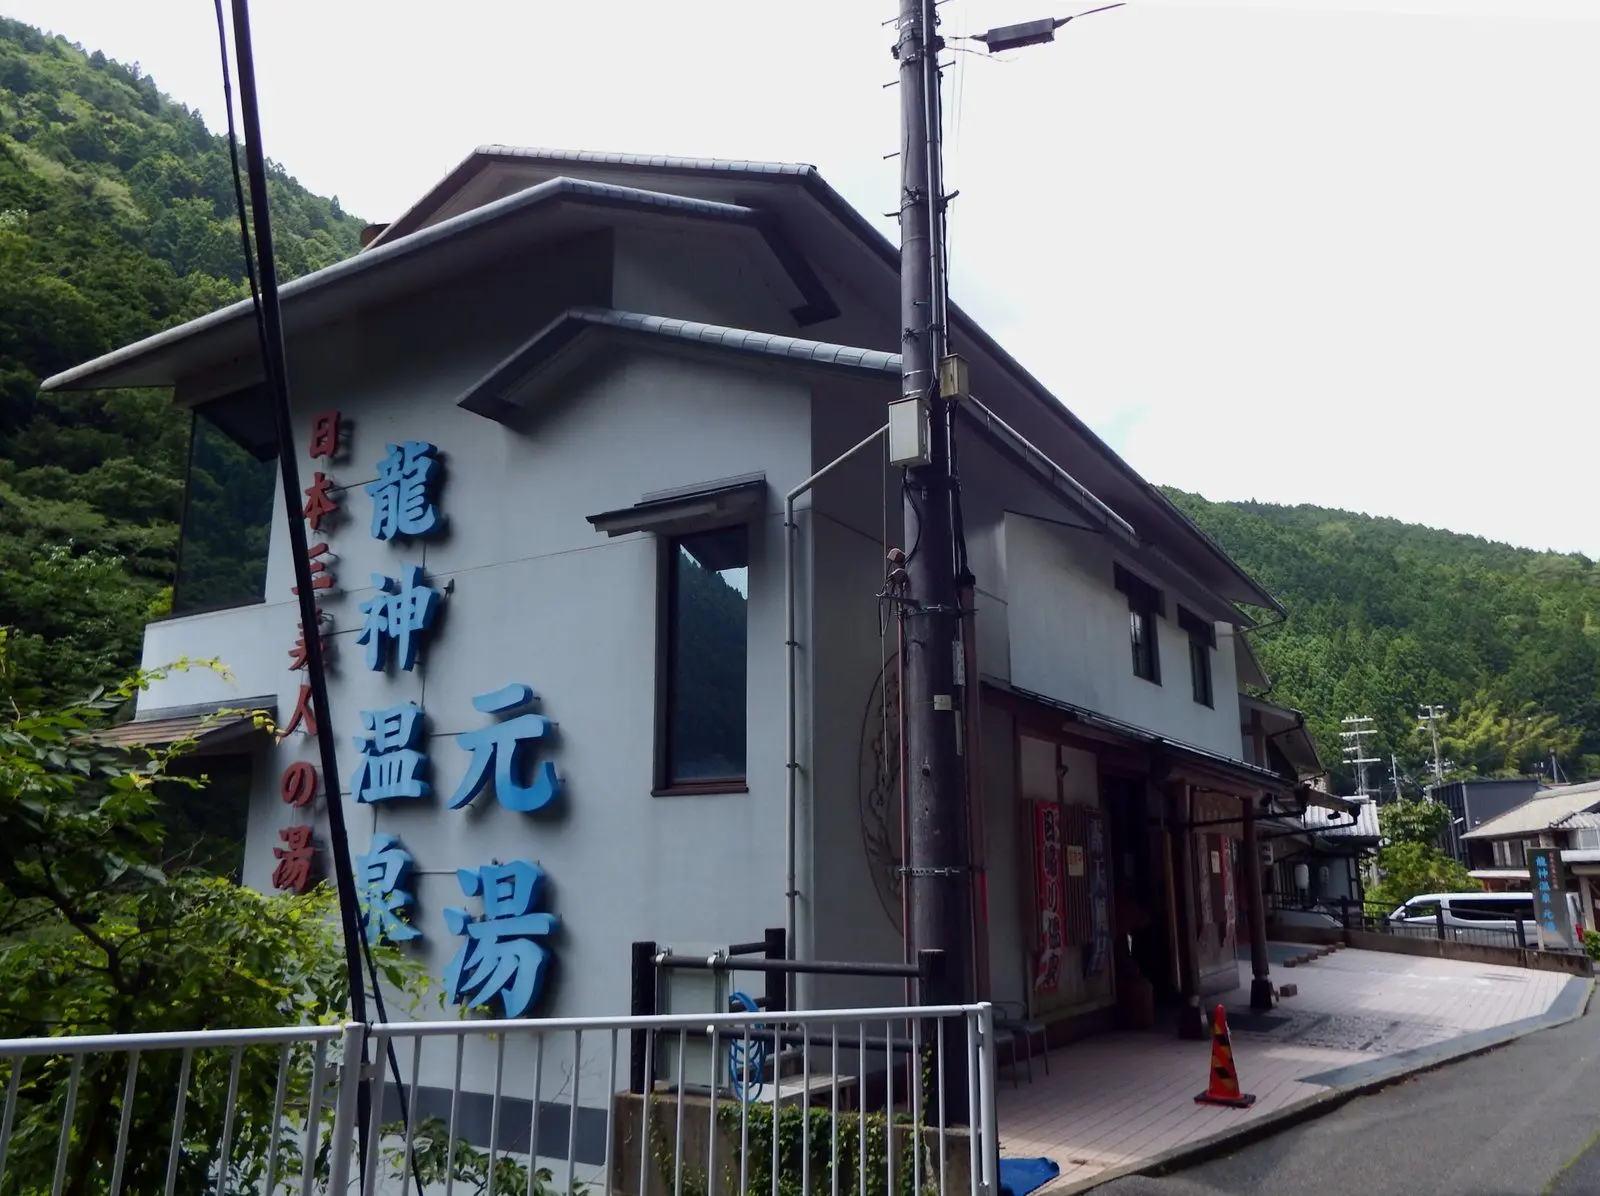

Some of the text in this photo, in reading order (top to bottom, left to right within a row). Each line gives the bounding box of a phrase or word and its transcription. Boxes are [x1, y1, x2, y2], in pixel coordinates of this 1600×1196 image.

[350, 440, 440, 945] 龍神温泉
[444, 683, 561, 1019] 元湯
